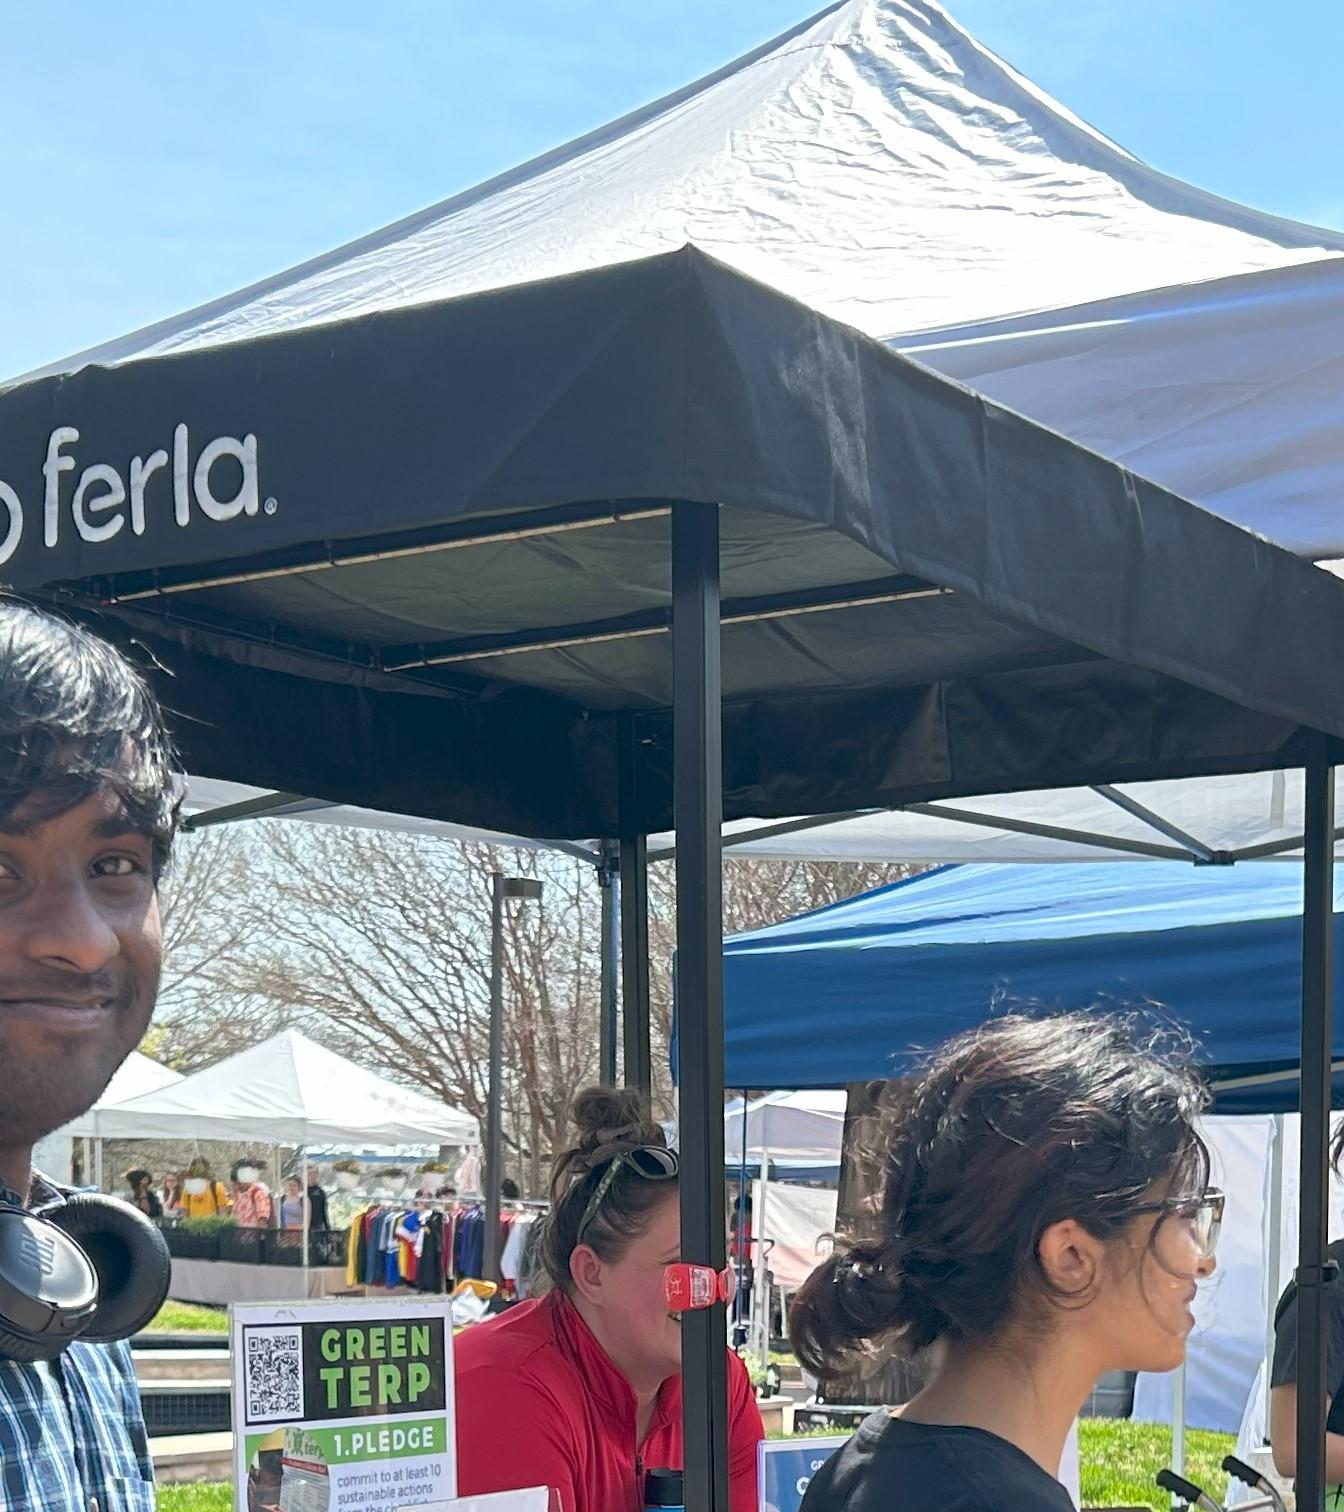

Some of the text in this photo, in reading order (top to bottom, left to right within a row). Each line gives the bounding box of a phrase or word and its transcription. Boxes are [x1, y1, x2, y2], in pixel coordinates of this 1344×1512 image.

[19, 1232, 56, 1275] JBL
[320, 1325, 430, 1362] GREEN
[319, 1362, 431, 1409] TERP
[334, 1425, 434, 1457] 1.PLEDGE
[337, 1463, 441, 1488] commit to at least 10
[337, 1482, 433, 1504] sustainable actions
